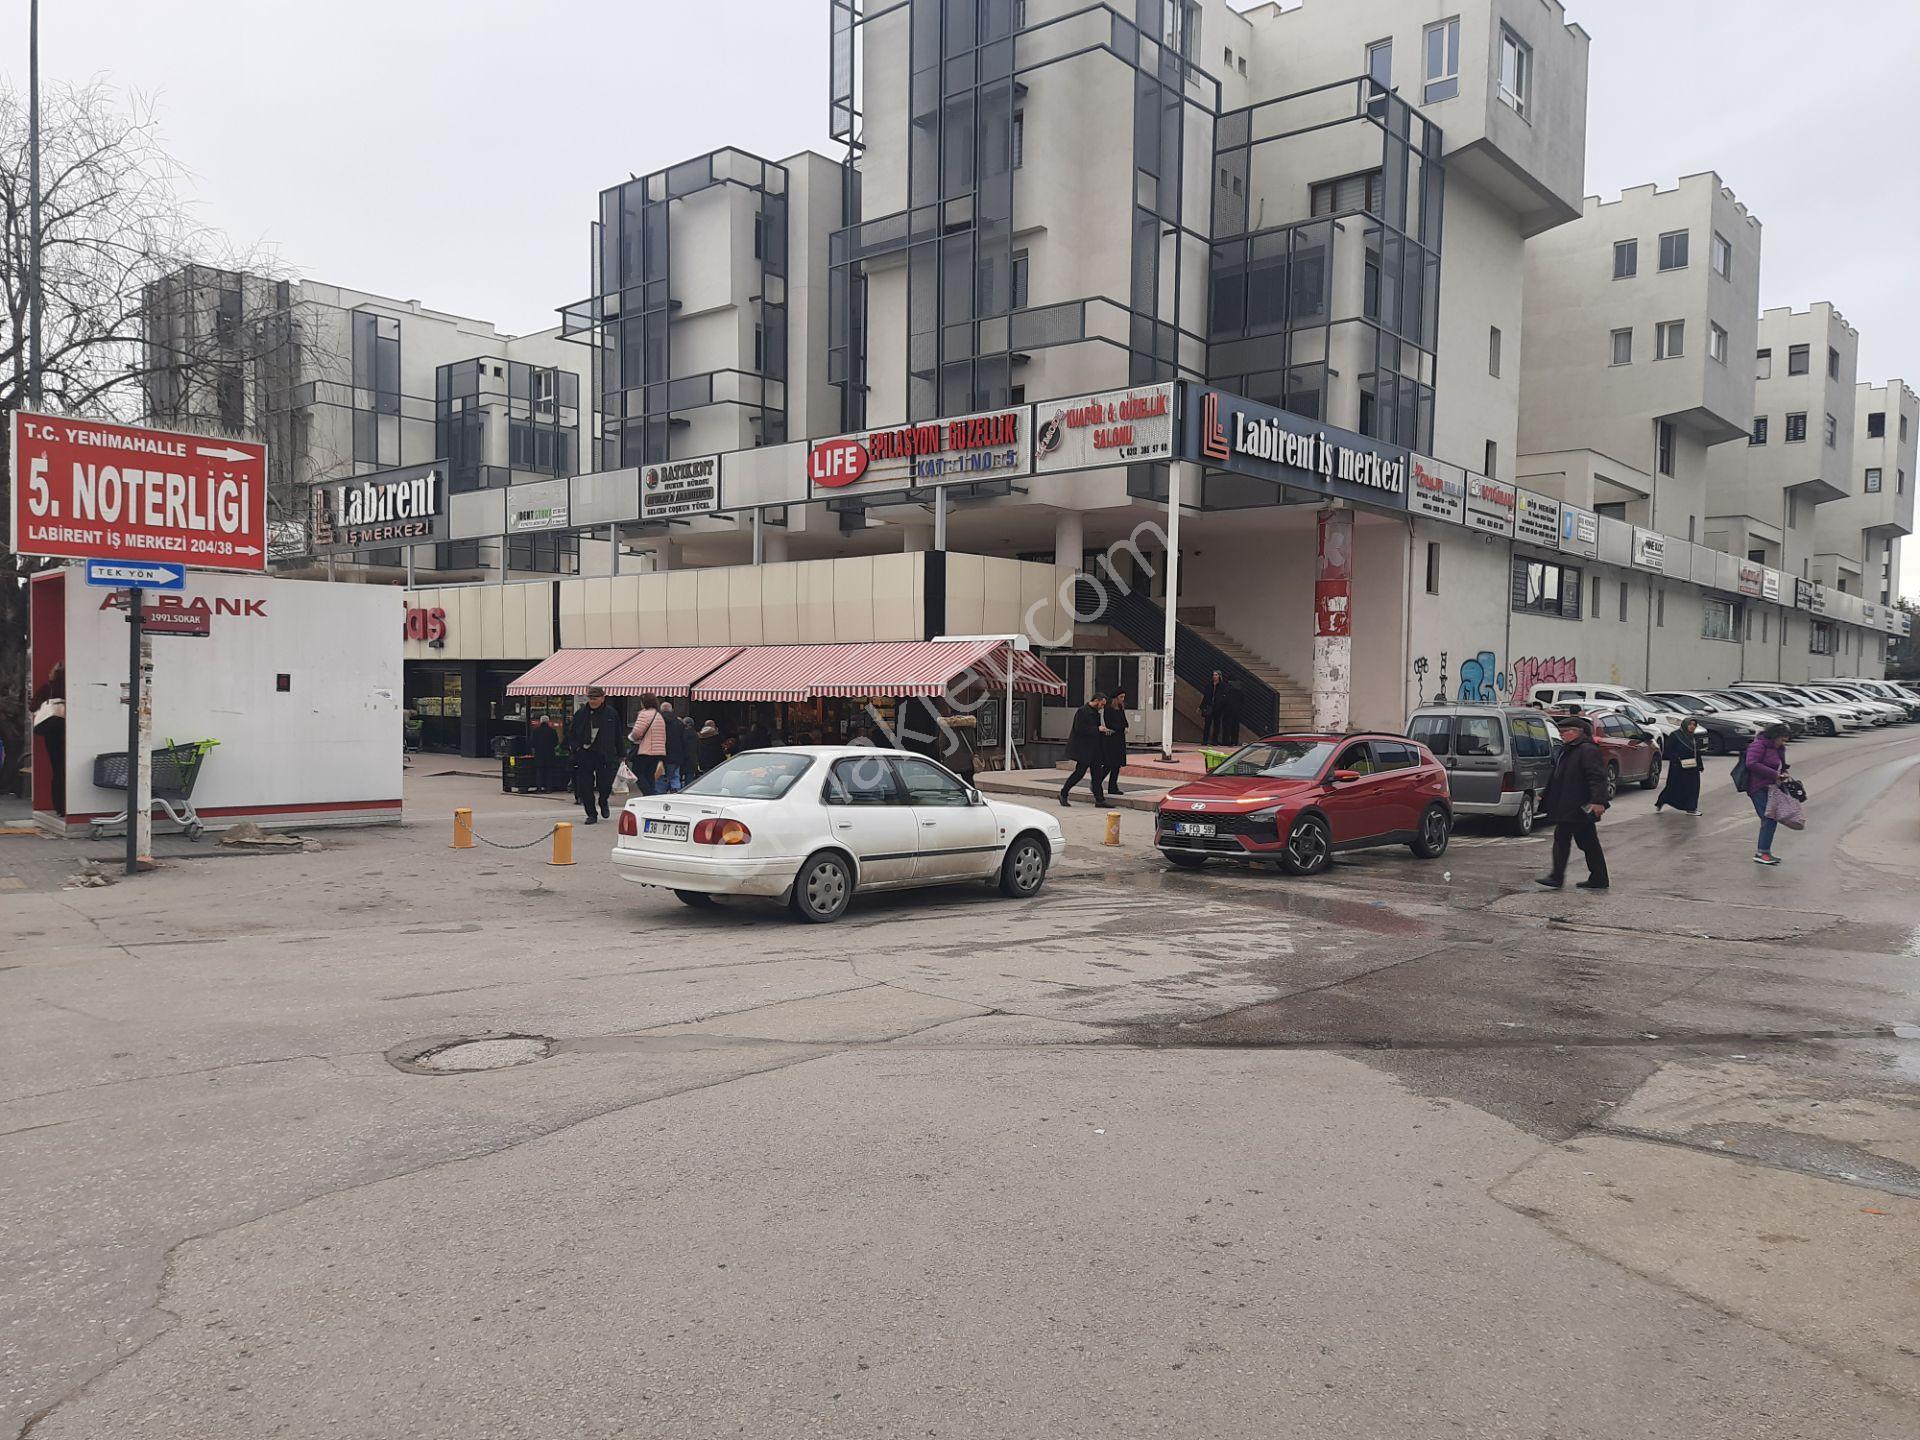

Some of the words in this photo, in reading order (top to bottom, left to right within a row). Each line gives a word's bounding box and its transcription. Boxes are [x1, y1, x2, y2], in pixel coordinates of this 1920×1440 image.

[1066, 398, 1104, 428] KUAFÖR
[1108, 403, 1116, 422] &
[1119, 388, 1168, 421] GÜZELLİK
[24, 423, 60, 442] T.C.
[66, 428, 187, 458] YENİMAHALLE
[869, 425, 941, 461] EPİLASYON
[949, 414, 1018, 450] GÜZELLİK
[1093, 425, 1134, 449] SALONU
[1235, 411, 1315, 472] Labirent
[1318, 431, 1333, 483] iş
[1338, 445, 1404, 494] merkezi
[661, 460, 714, 482] BATIKENT
[814, 447, 857, 478] LIFE
[29, 455, 59, 517] 5.
[72, 462, 249, 534] NOTERLİĞİ
[338, 469, 436, 527] Labirent
[28, 524, 103, 544] LABİRENT
[107, 529, 120, 549] İŞ
[125, 533, 187, 551] MERKEZİ
[190, 539, 233, 555] 204/38
[361, 518, 429, 542] MERKEZİ
[99, 568, 122, 577] TEK
[128, 568, 154, 579] YÖN
